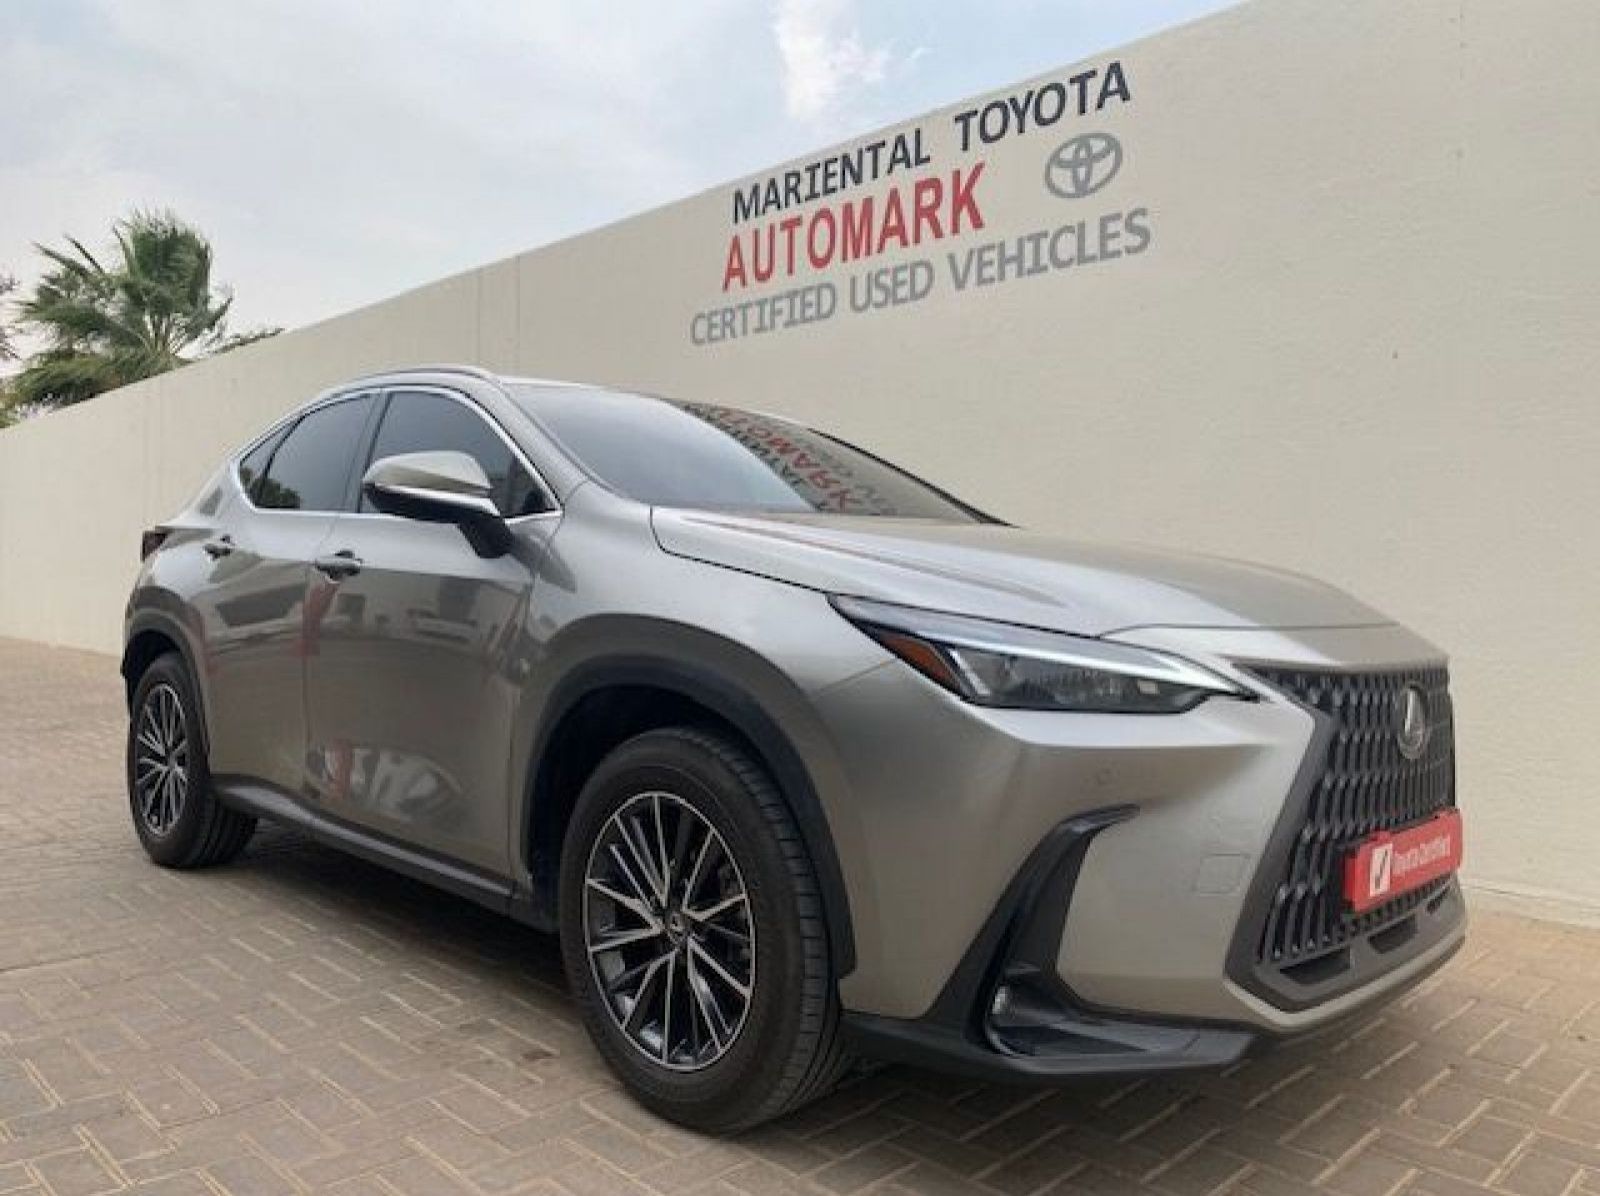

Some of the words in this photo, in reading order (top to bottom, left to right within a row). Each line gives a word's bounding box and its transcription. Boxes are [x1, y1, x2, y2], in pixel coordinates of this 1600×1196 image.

[733, 129, 930, 223] MARIENTAL
[955, 62, 1131, 151] TOYOTA
[690, 283, 836, 345] CERTIFIED
[849, 259, 935, 313] USED
[947, 207, 1151, 291] VEHICLES
[722, 163, 985, 291] AUTOMARK
